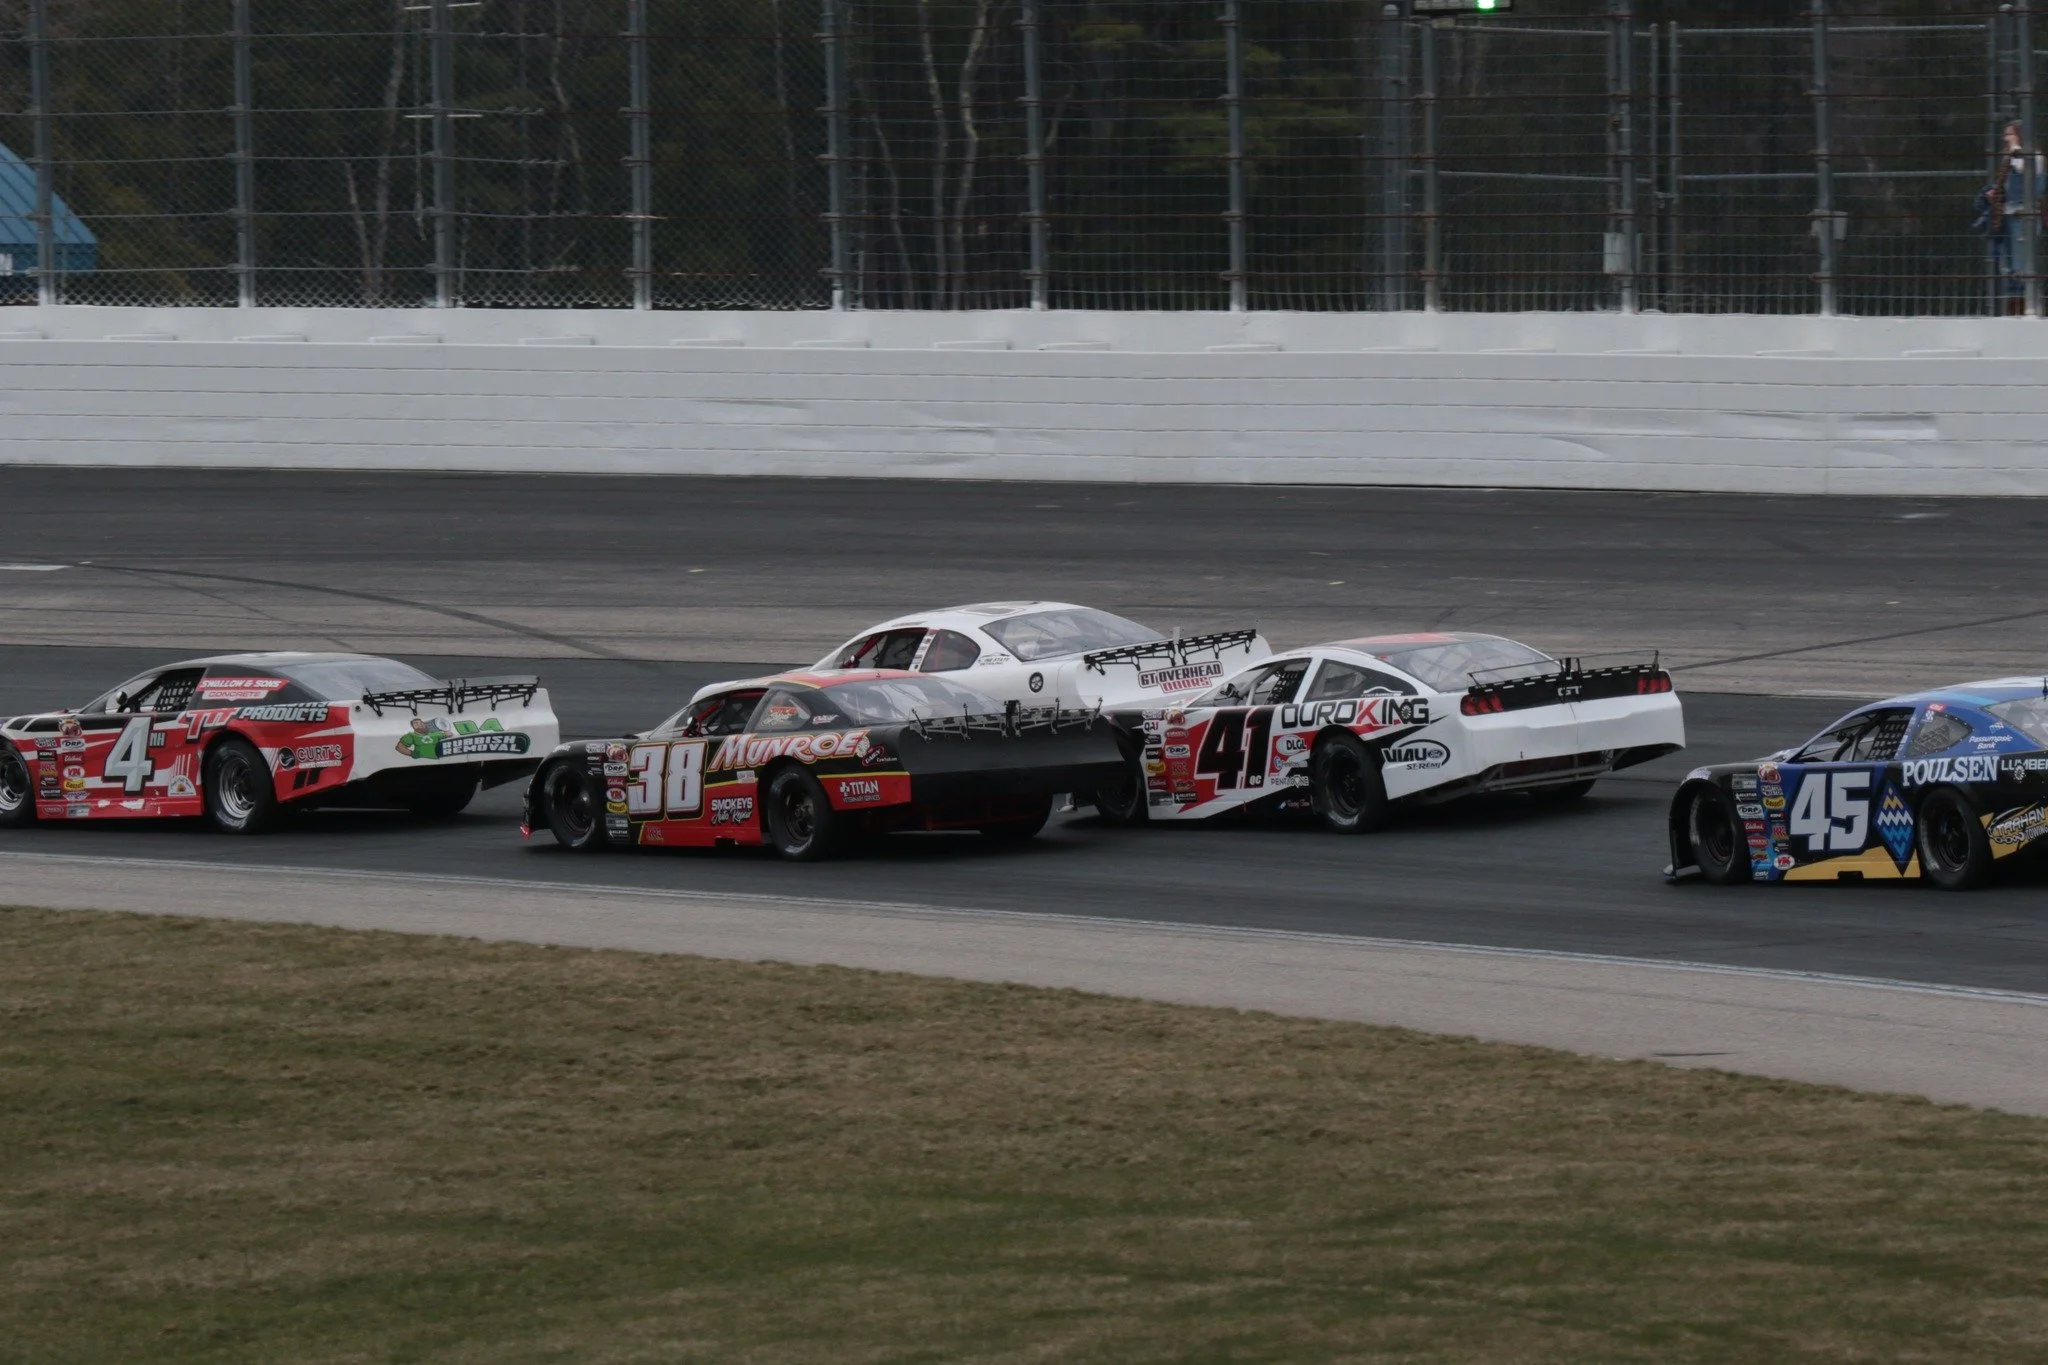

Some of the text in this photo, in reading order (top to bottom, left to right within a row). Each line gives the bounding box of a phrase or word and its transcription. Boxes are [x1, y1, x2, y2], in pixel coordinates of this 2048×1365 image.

[1159, 664, 1222, 682] OVERHEAD
[200, 680, 282, 688] SWALLOW & SONS
[1163, 677, 1209, 691] DOORS
[239, 707, 329, 722] PRODUCTS
[150, 732, 166, 747] NH
[442, 735, 516, 750] RUBBISH
[1286, 739, 1307, 751] DLGL
[1968, 735, 2013, 744] Passumpsic
[104, 716, 152, 792] 4
[297, 744, 342, 762] CURT'S
[443, 745, 521, 756] REMOVAL
[1195, 706, 1275, 789] 41
[1382, 748, 1427, 762] VIAU
[1902, 756, 1999, 787] POULSEN
[628, 741, 708, 818] 38
[849, 779, 879, 795] TITAN
[711, 797, 753, 811] SMOKEYS
[1790, 771, 1870, 851] 45
